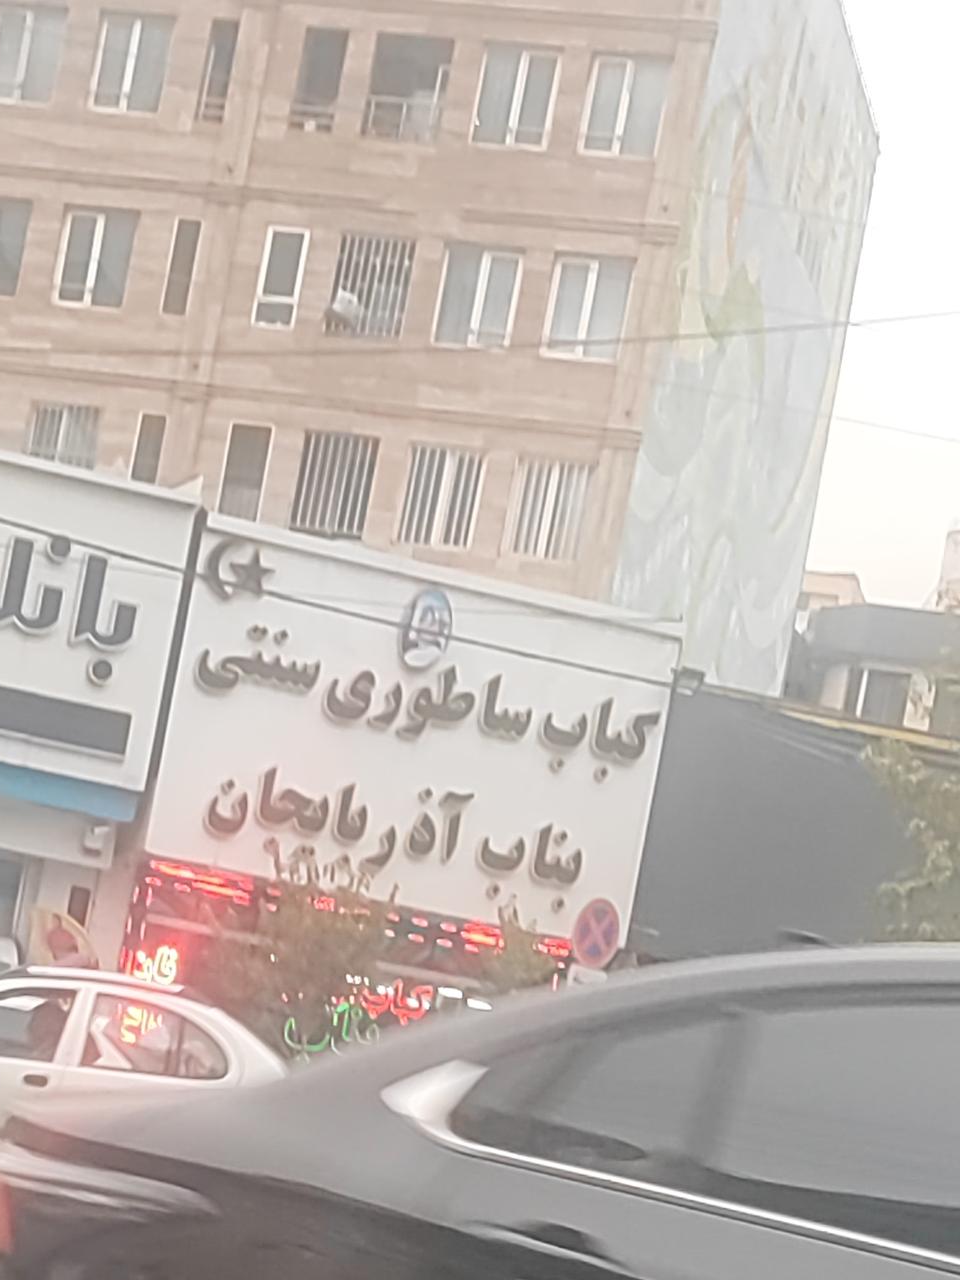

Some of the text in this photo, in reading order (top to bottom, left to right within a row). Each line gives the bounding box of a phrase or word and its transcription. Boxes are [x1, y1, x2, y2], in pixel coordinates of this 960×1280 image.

[195, 624, 661, 782] کباب ساطوری سنتی
[476, 823, 583, 913] بناب
